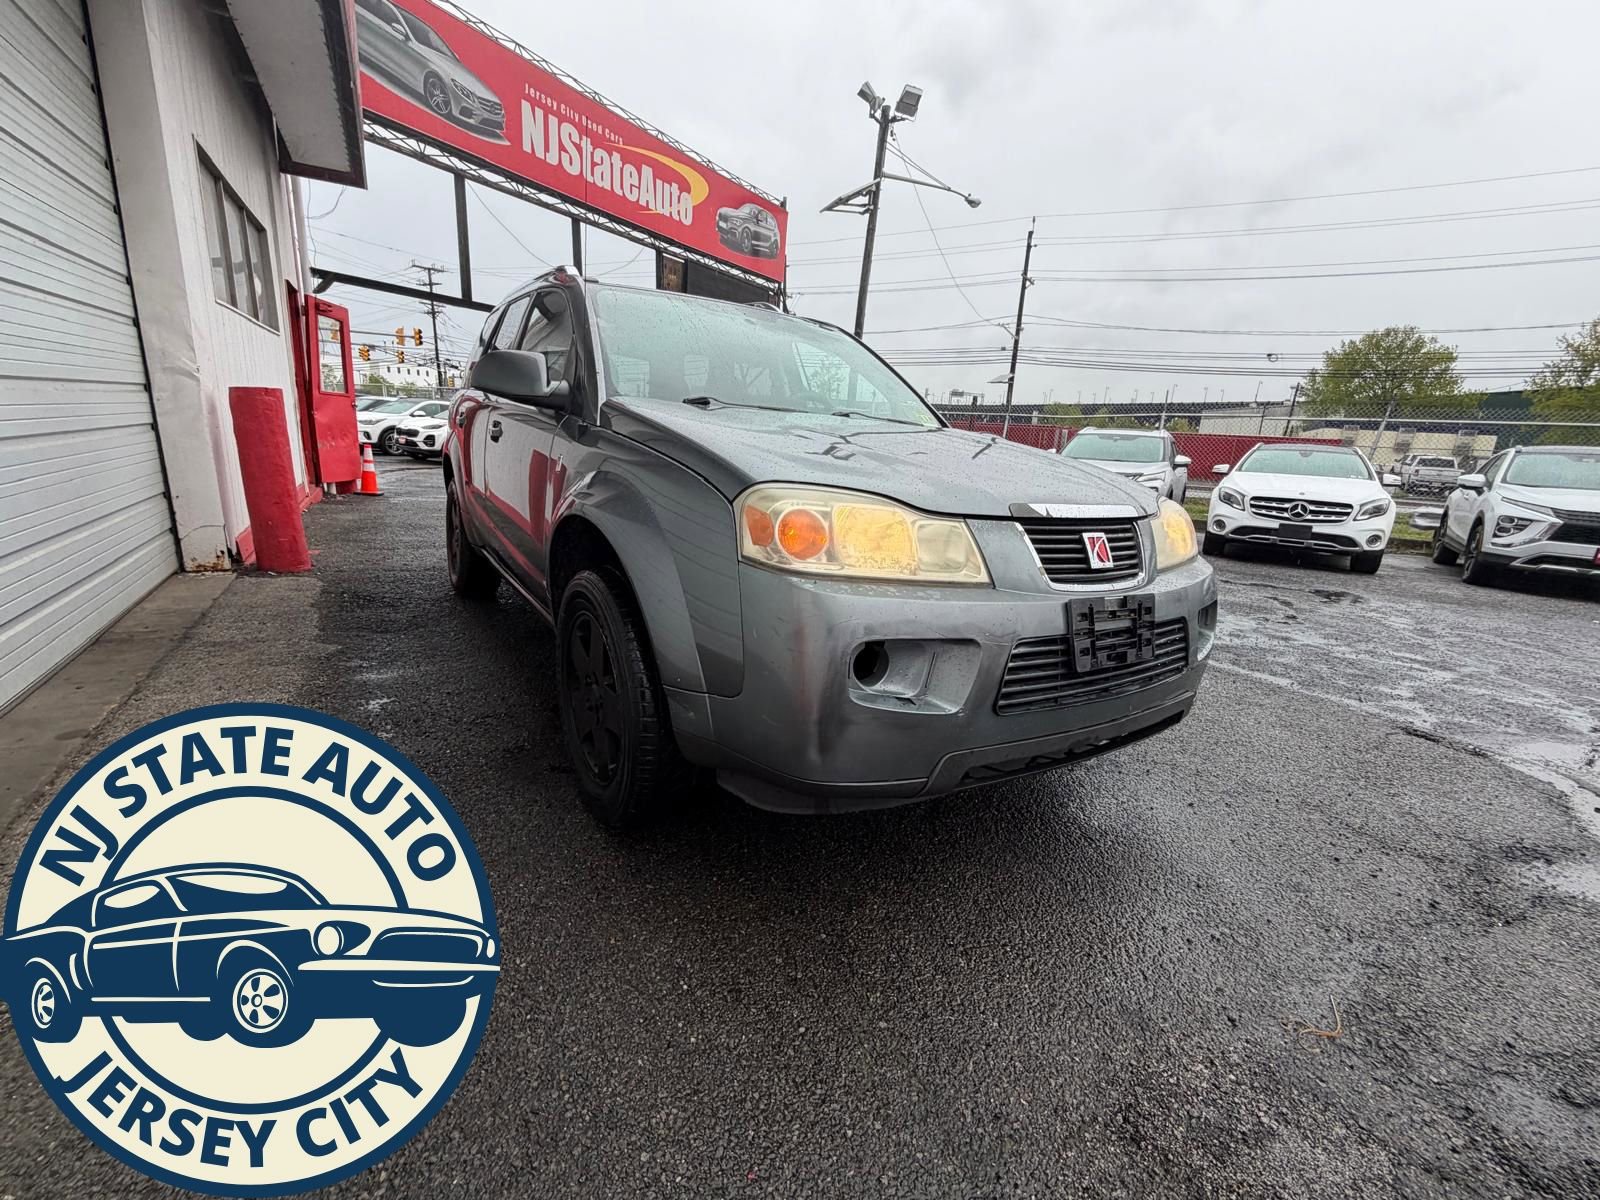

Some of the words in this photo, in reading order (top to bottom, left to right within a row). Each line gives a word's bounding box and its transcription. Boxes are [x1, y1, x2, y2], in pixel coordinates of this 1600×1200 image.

[524, 83, 557, 111] Jersey
[560, 103, 579, 123] City
[581, 115, 603, 135] Used
[605, 128, 623, 145] Cars
[521, 99, 693, 226] NJStateAuto
